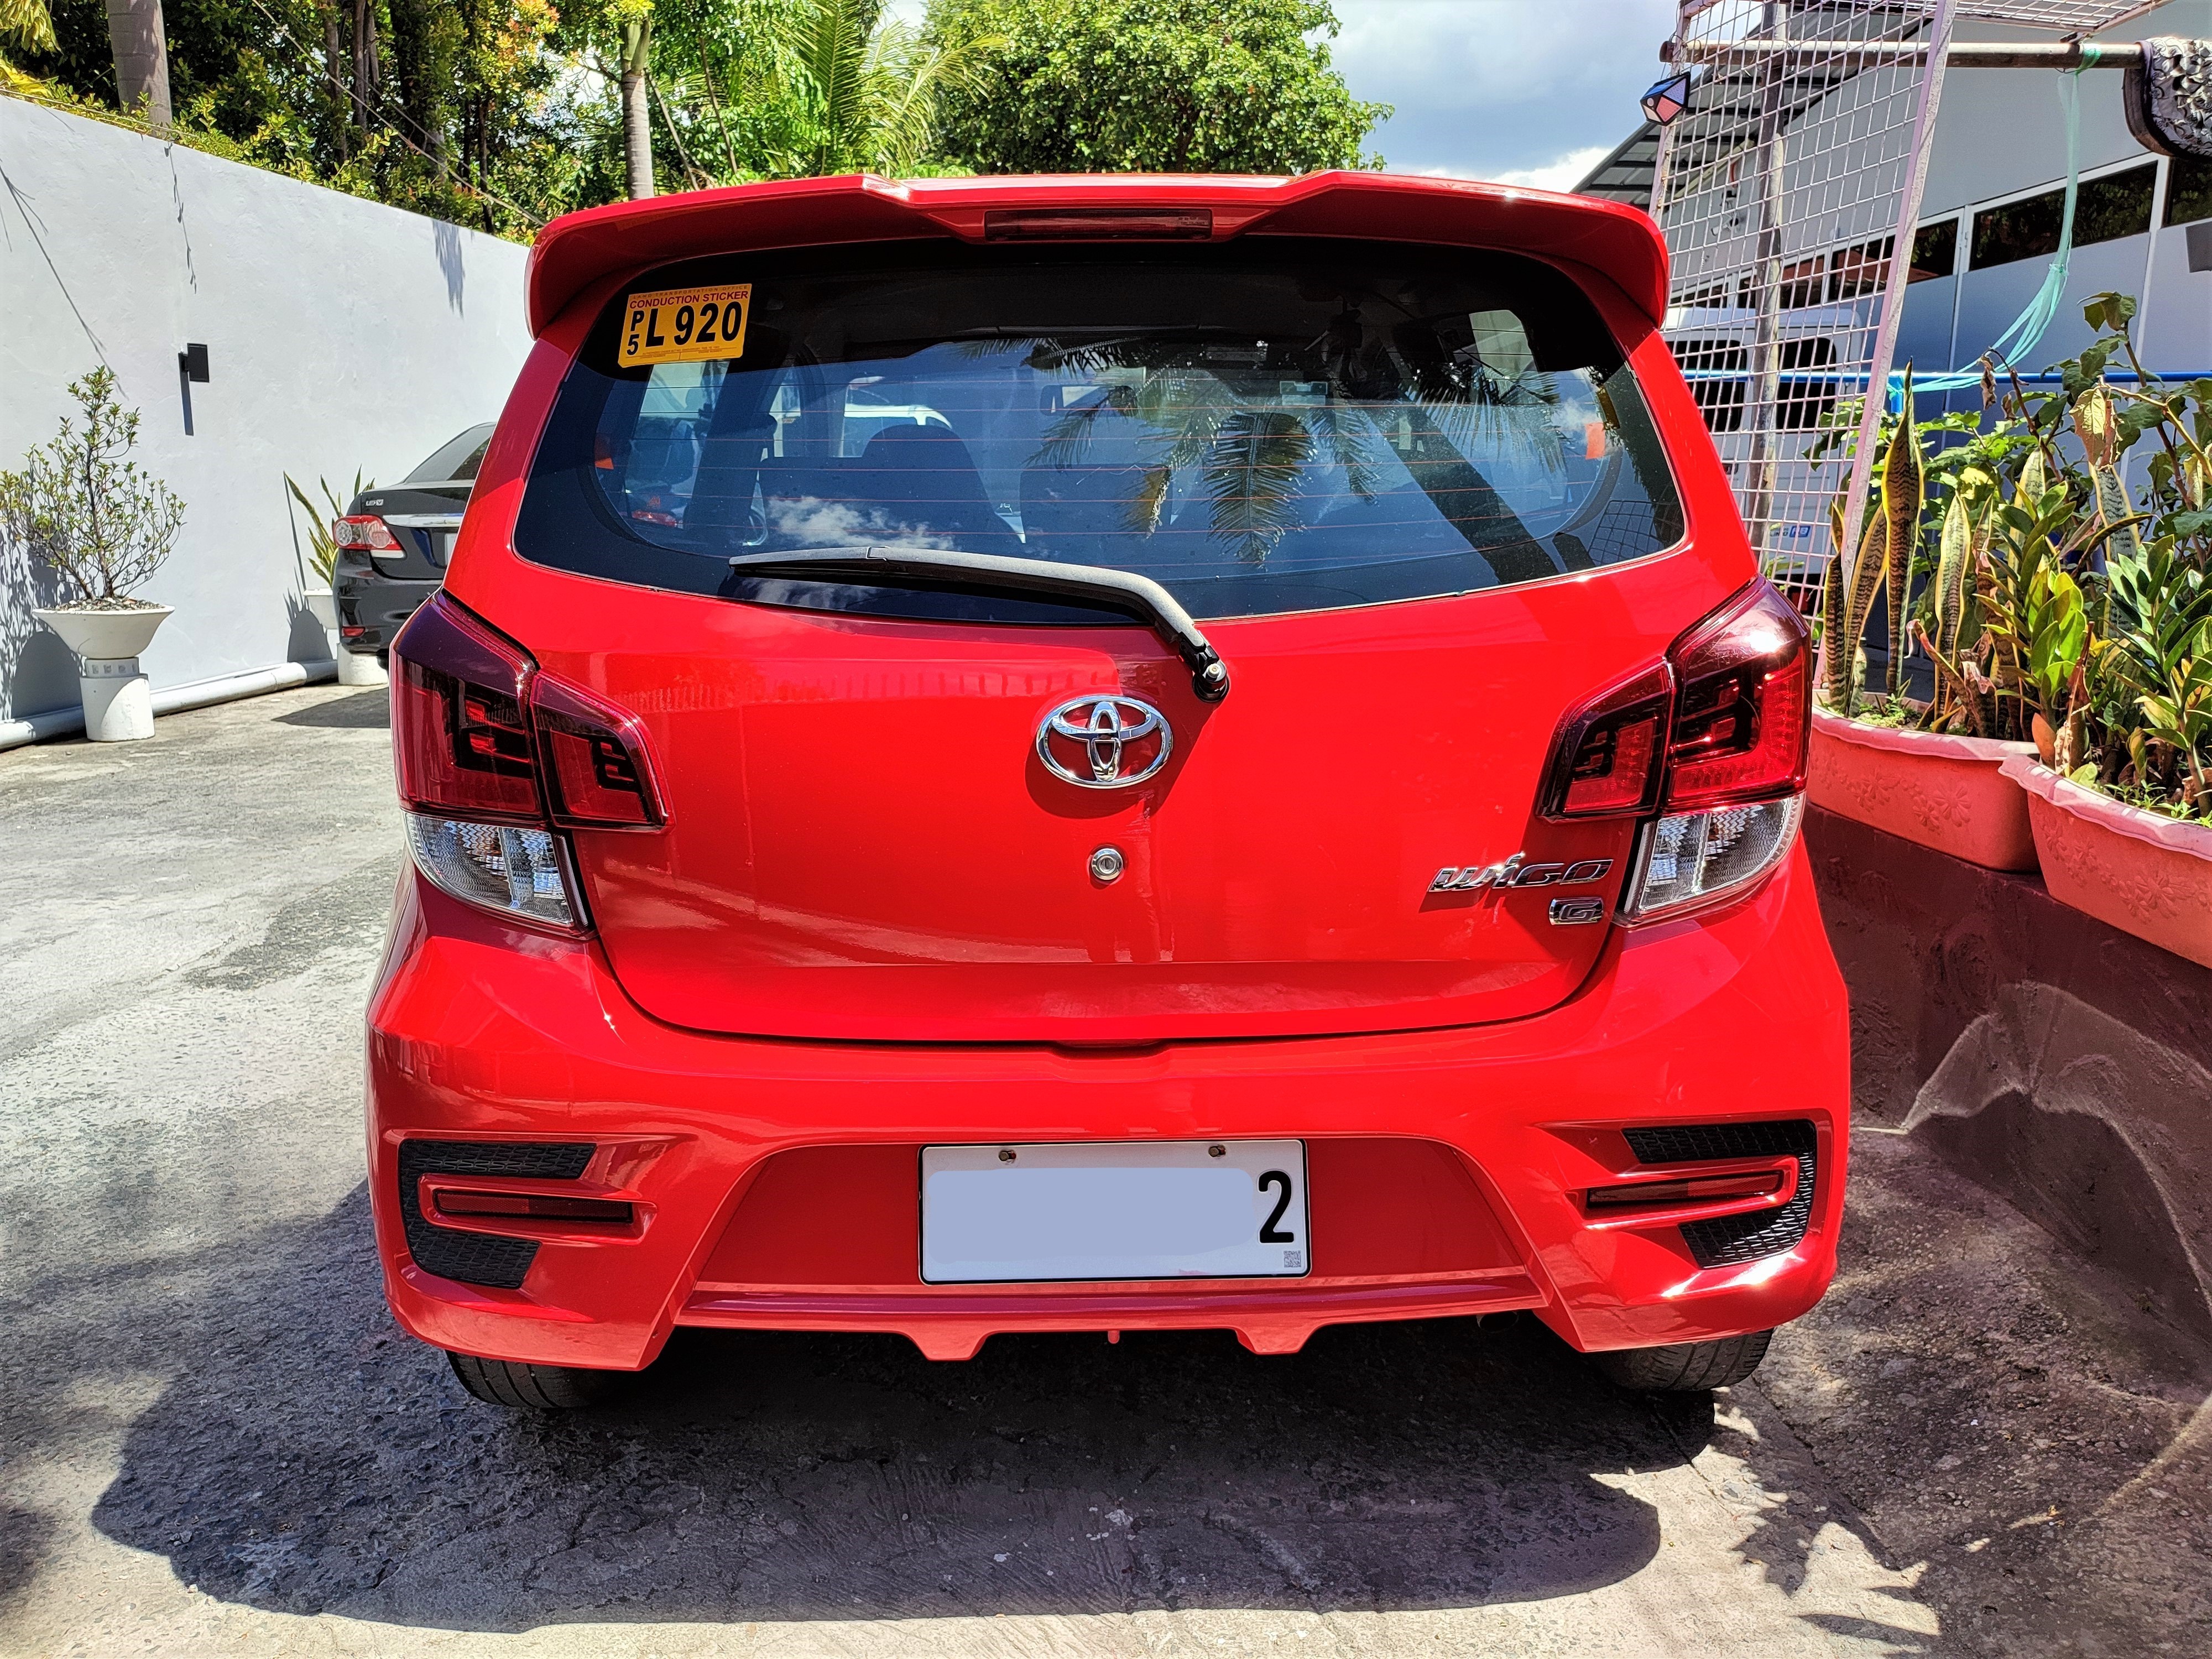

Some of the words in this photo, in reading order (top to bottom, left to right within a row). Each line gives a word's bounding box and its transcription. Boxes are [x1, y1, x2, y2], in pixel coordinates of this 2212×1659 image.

[629, 295, 701, 309] CONDUCTION
[702, 291, 748, 302] STICKER
[655, 287, 718, 296] TRANSPORTATION
[630, 311, 644, 331] P
[674, 301, 742, 346] 920
[627, 334, 640, 356] 5
[1258, 1170, 1295, 1244] 2
